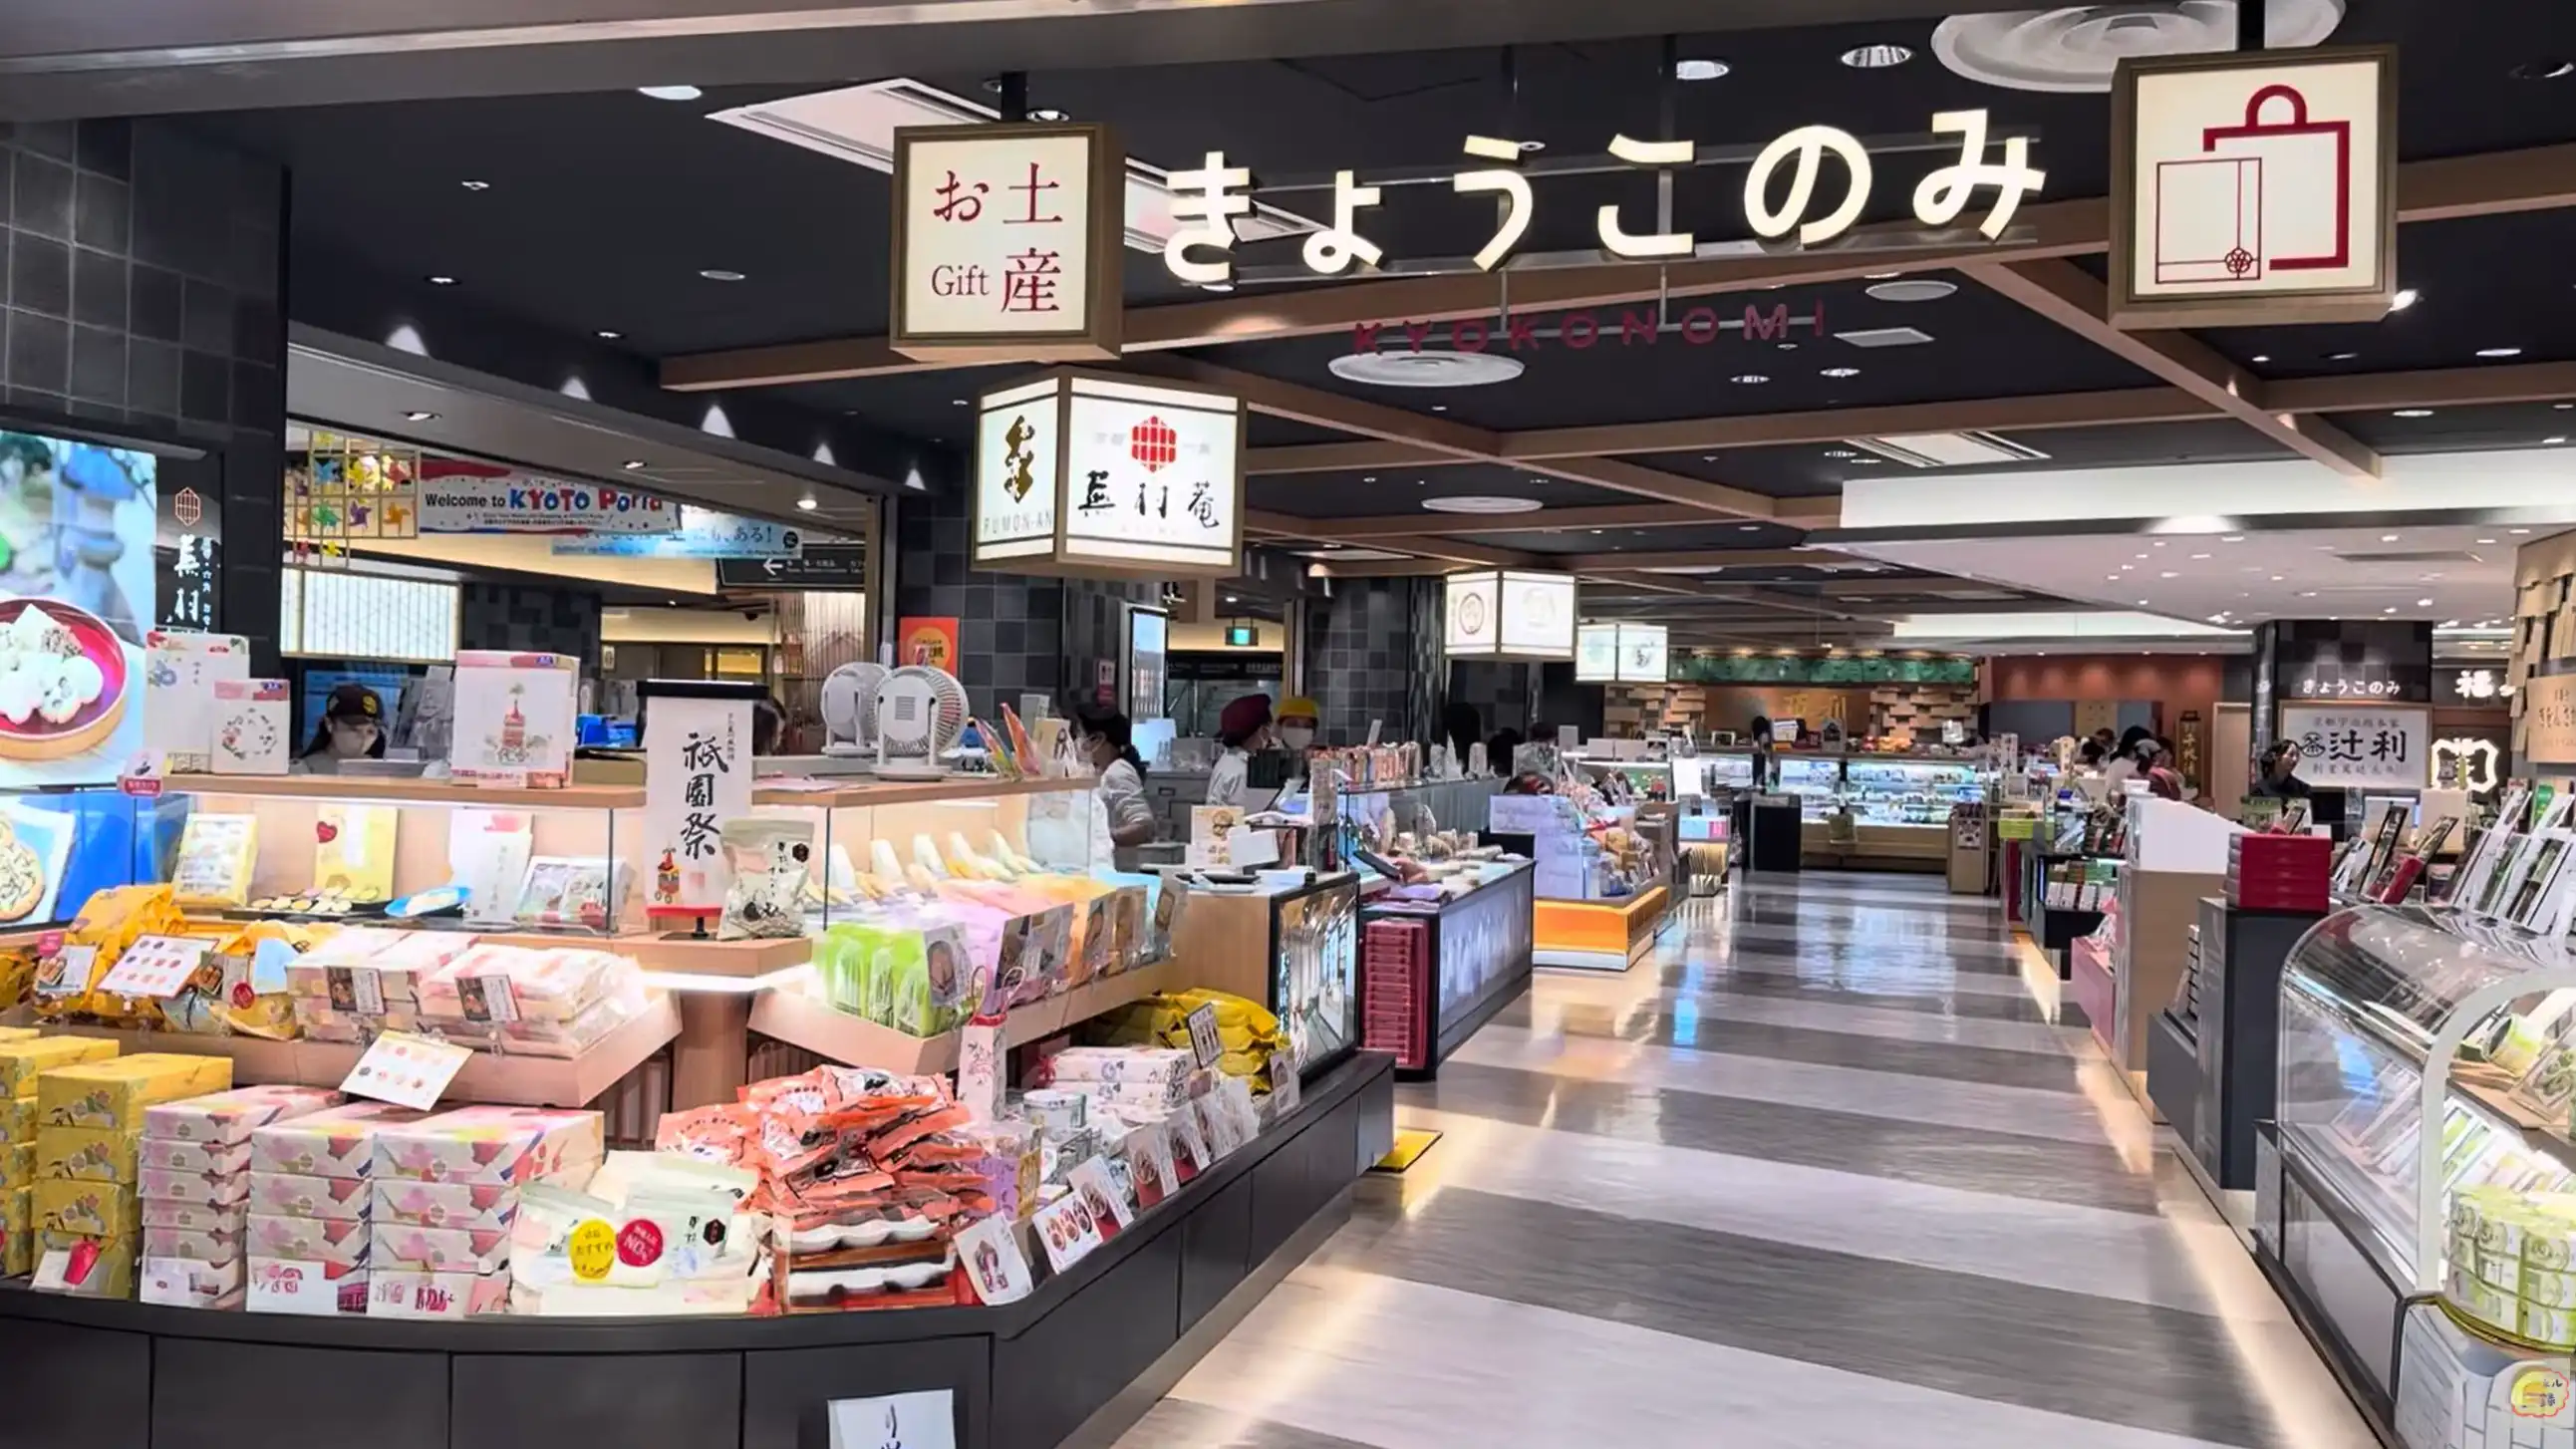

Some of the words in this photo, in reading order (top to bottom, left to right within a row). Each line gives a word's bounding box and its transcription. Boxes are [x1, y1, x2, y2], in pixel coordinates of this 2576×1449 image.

[1164, 108, 2046, 284] きょうこのみ
[931, 264, 991, 298] Gift
[1354, 298, 1825, 356] KYOKONOMI
[425, 492, 487, 508] Welcome
[491, 494, 506, 508] to
[509, 488, 592, 511] KYOTO
[2302, 678, 2401, 695] きょうこのみ
[681, 732, 728, 860] 祇園祭
